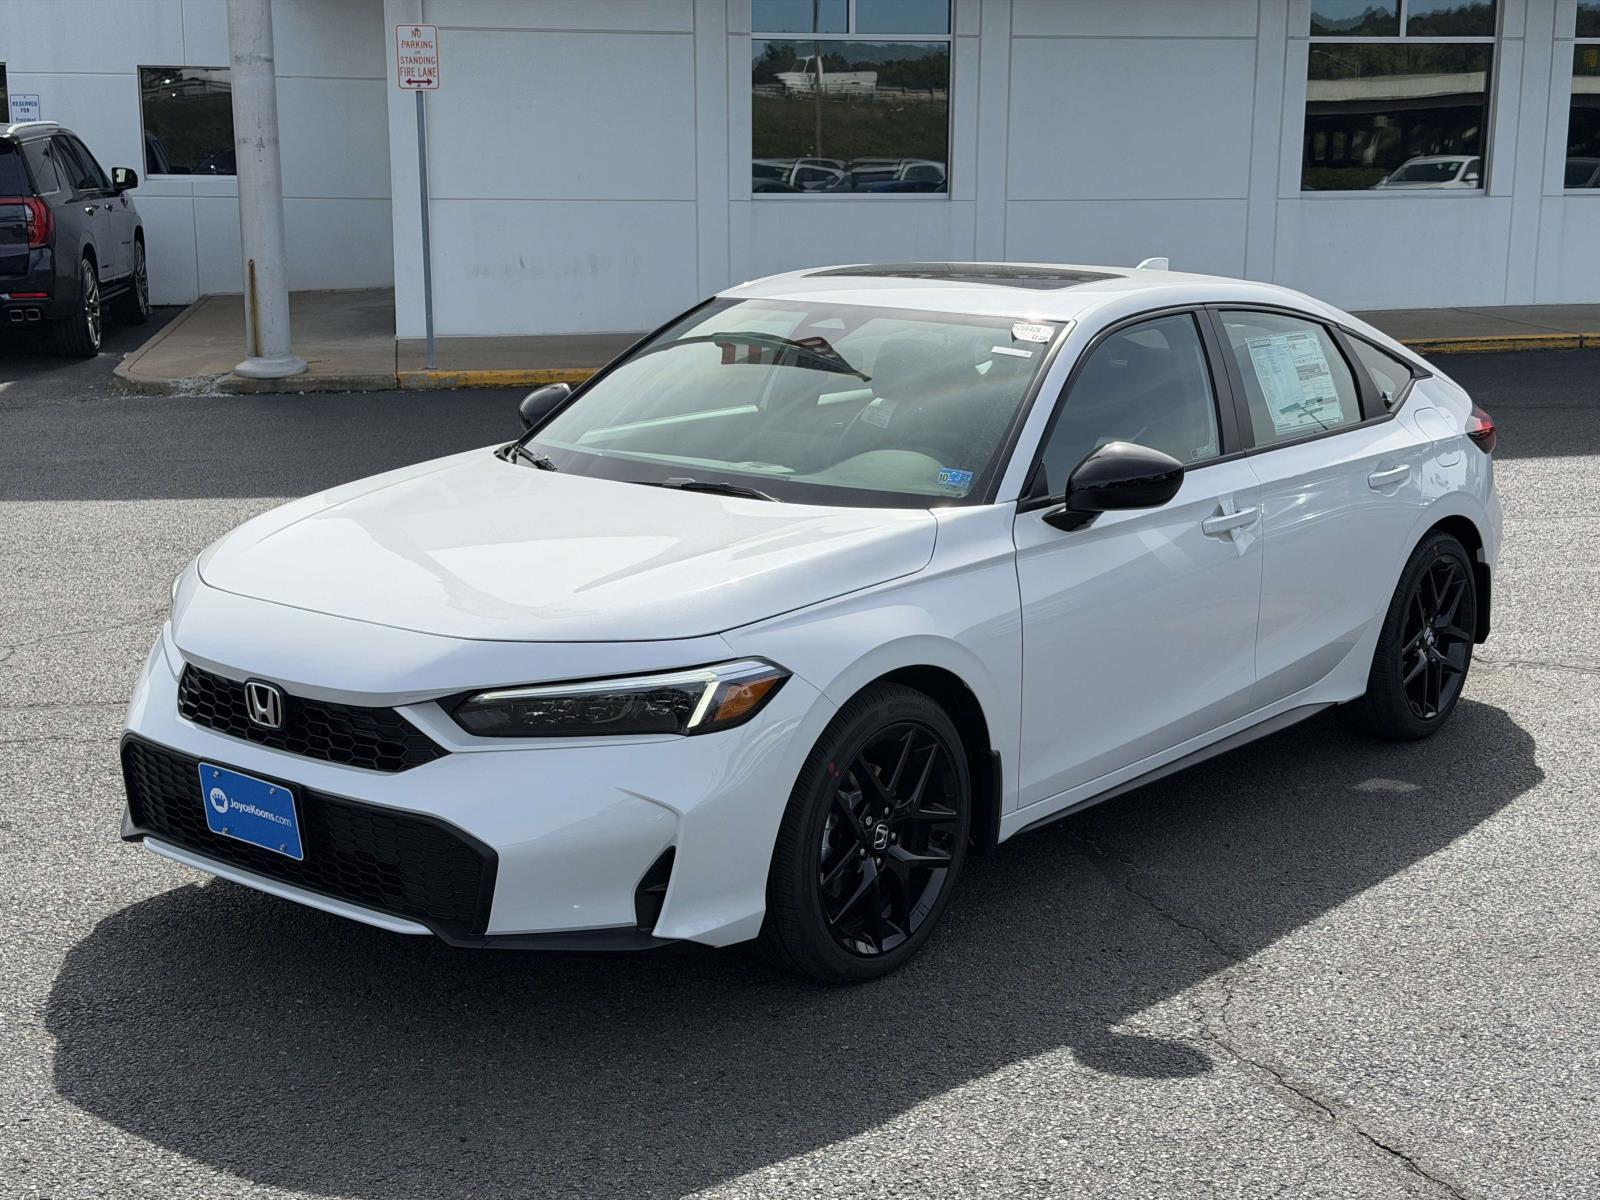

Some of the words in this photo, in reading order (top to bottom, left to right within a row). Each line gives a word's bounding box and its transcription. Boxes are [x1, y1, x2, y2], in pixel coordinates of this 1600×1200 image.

[411, 29, 422, 38] NO
[401, 40, 433, 49] PARKING
[400, 56, 436, 65] STANDING
[400, 67, 416, 77] FIRE
[418, 67, 437, 77] LANE
[229, 798, 292, 827] JoyceKoons.com
